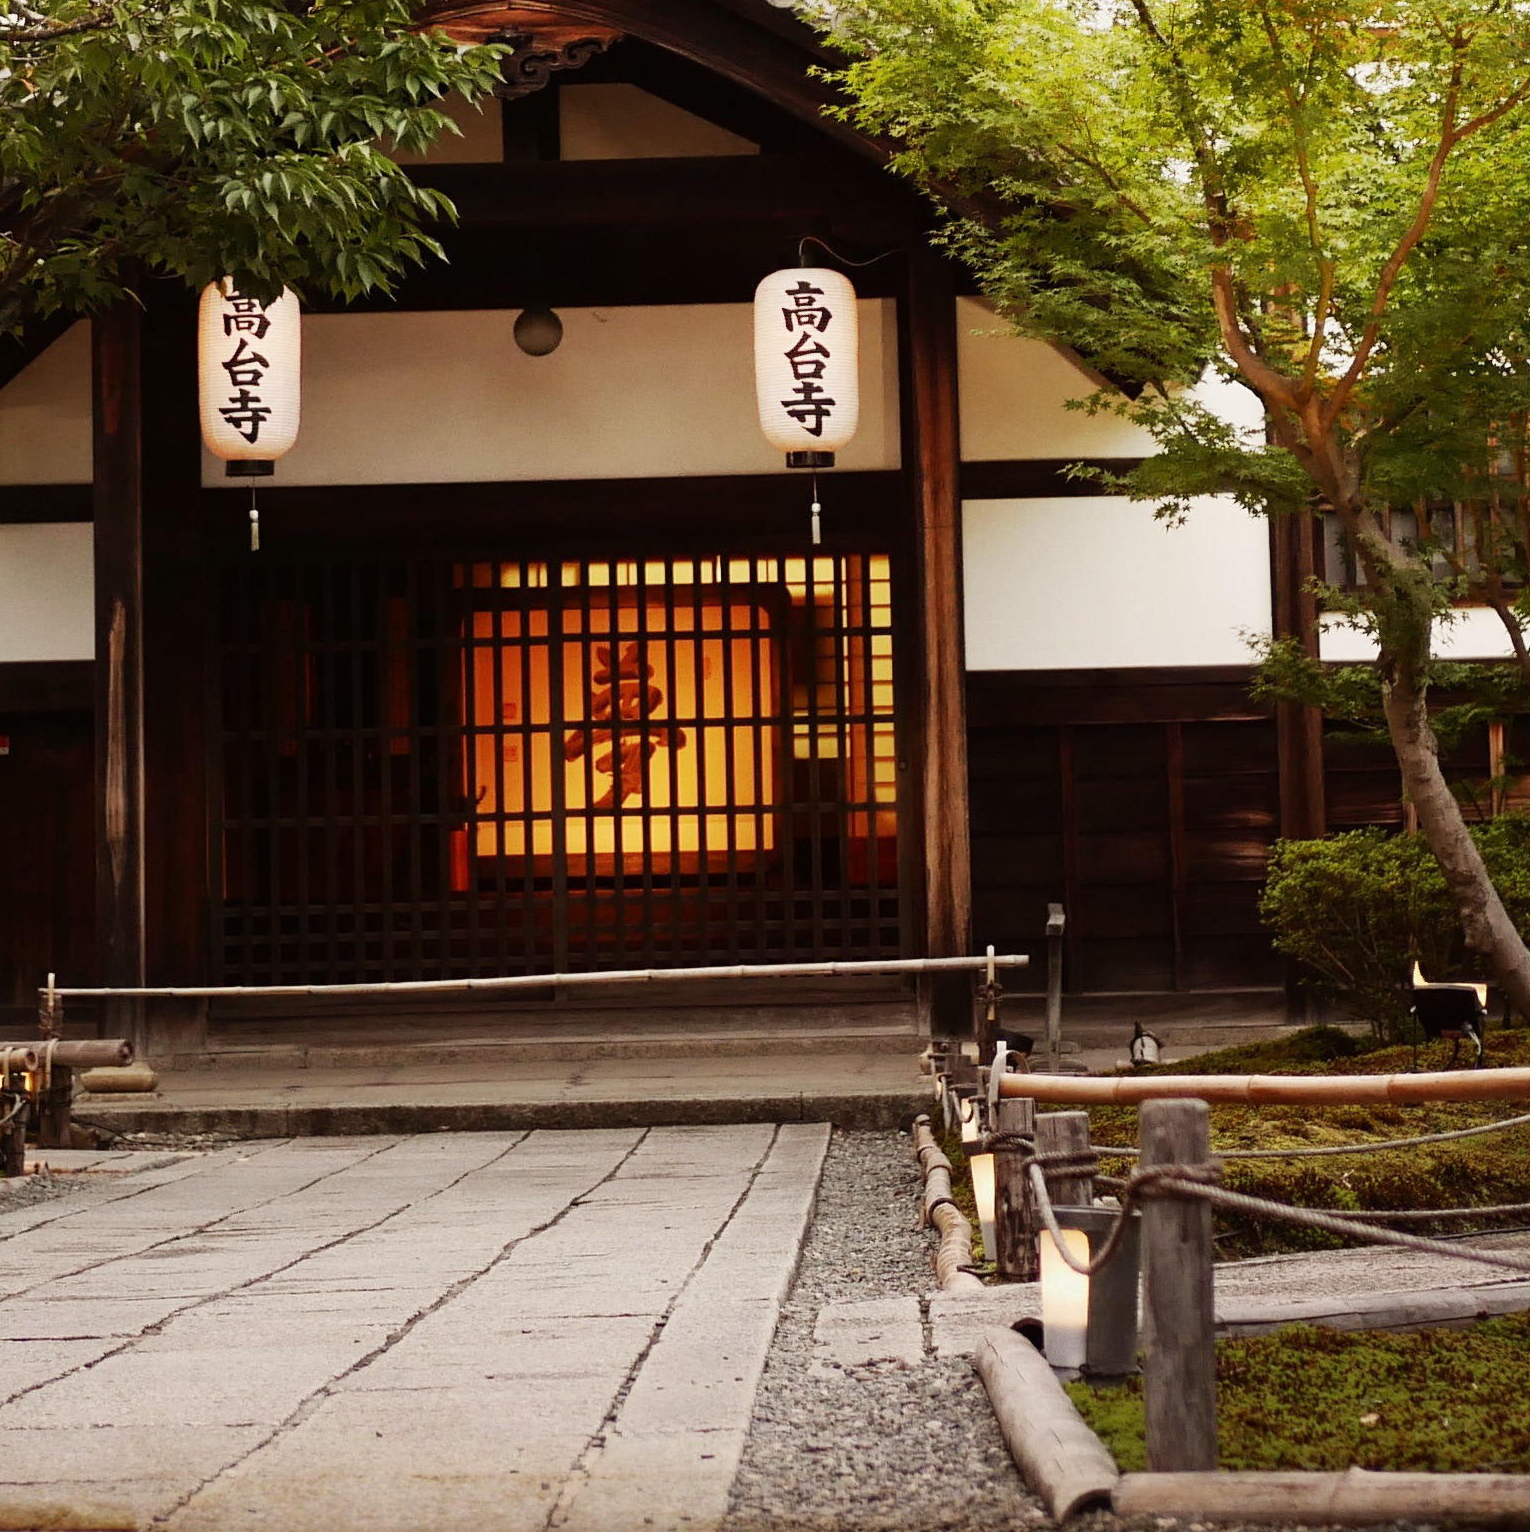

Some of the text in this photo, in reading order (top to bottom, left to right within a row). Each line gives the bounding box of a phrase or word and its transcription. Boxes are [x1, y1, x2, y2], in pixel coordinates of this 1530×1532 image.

[218, 294, 272, 444] 高台寺
[780, 280, 836, 437] 高台寺
